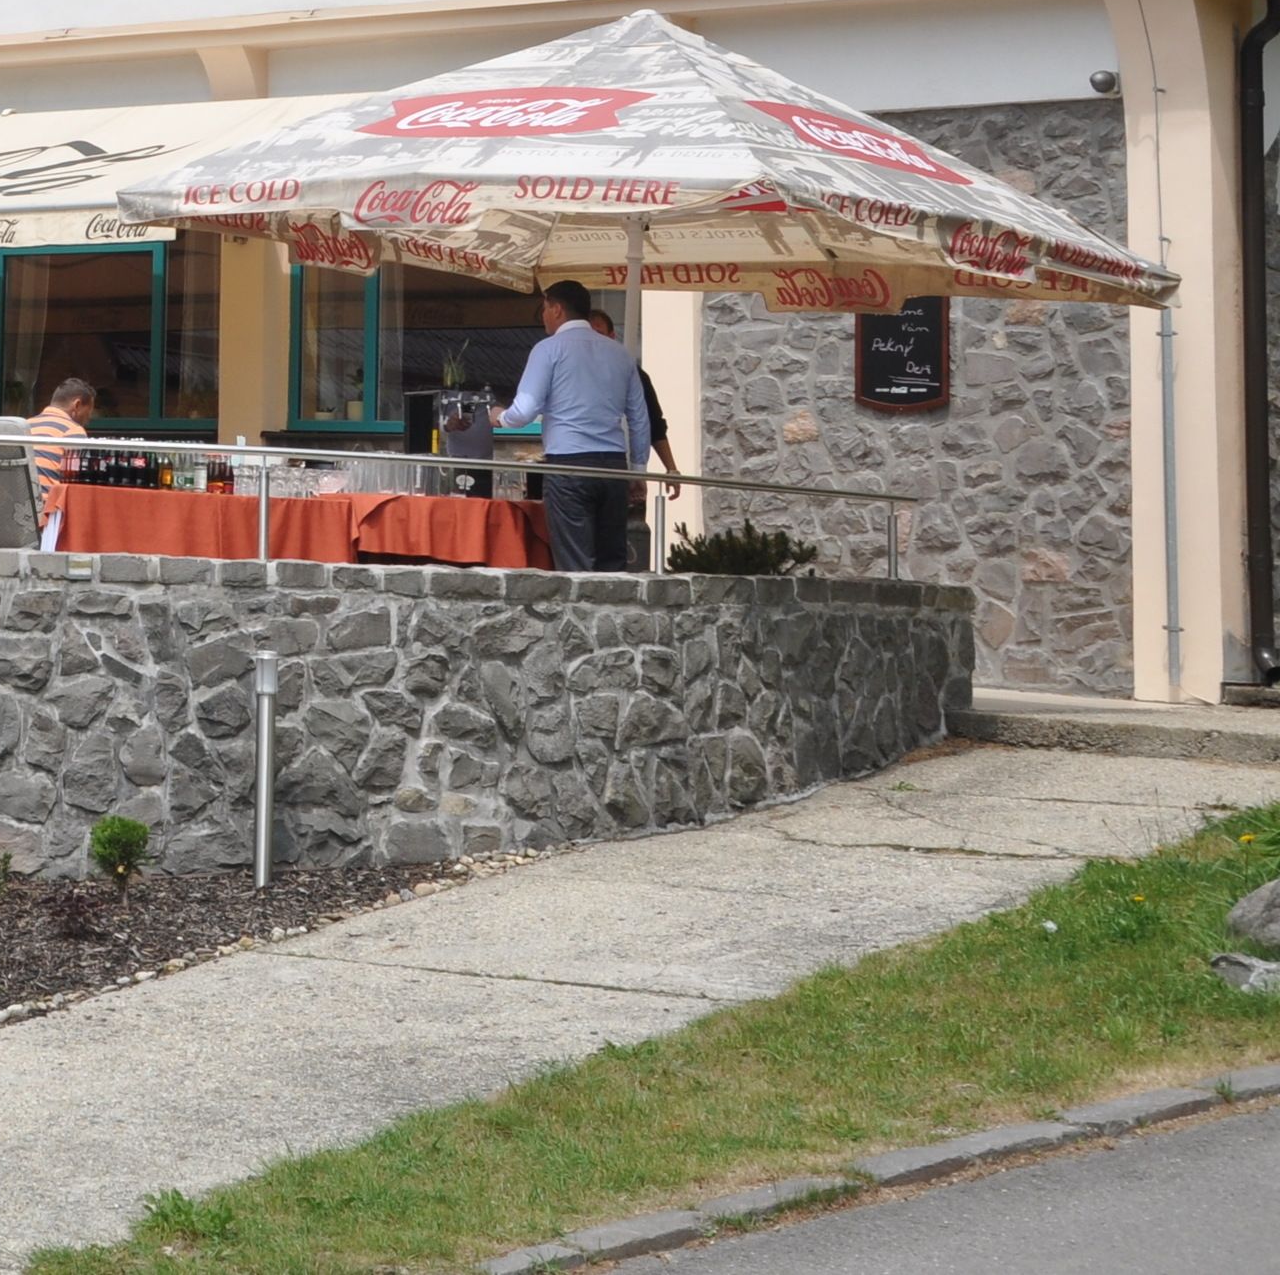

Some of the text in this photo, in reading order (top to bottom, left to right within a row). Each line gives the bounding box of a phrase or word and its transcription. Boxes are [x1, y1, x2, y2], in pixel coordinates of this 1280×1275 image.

[183, 179, 301, 205] ICE COLD
[353, 179, 481, 223] Coca-Cola
[514, 175, 681, 205] SOLD HERE
[855, 197, 912, 226] COLD
